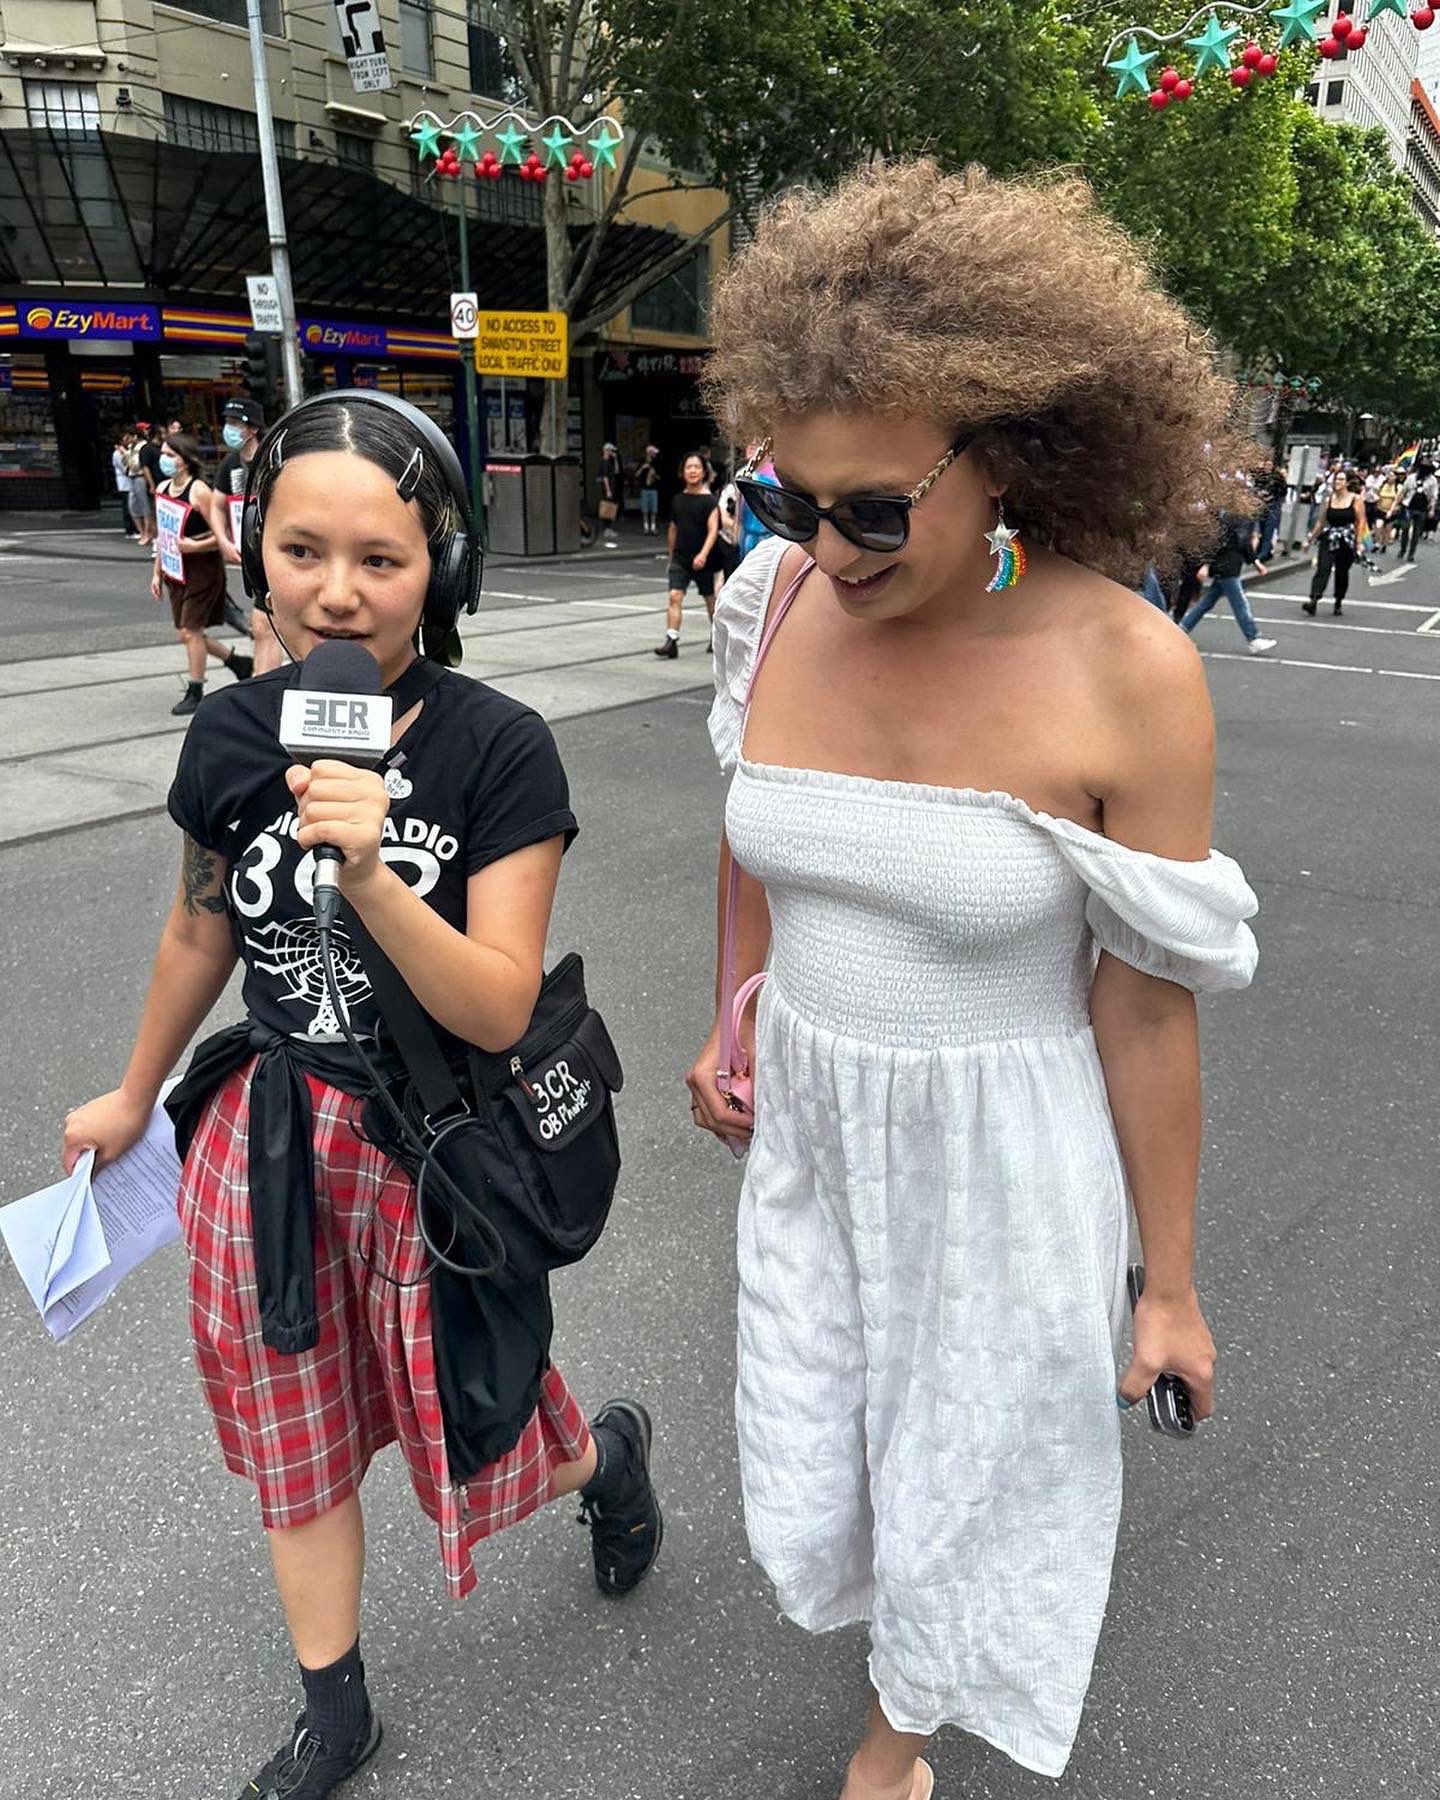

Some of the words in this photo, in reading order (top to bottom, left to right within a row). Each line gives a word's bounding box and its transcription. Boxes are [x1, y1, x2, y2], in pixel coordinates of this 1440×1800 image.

[352, 70, 369, 80] FROM
[371, 66, 388, 78] LEFT
[363, 79, 380, 89] ONLY
[256, 283, 269, 296] NO
[455, 308, 475, 324] 40
[486, 319, 500, 332] NO
[502, 319, 540, 333] ACCESS
[543, 320, 556, 334] TO
[481, 337, 528, 351] SWANSTON
[529, 338, 562, 353] STREET
[480, 355, 504, 369] LOCAL
[506, 356, 540, 371] TRAFFIC
[541, 357, 563, 372] ONLY
[531, 1060, 579, 1113] 3CR
[539, 1111, 563, 1140] OB
